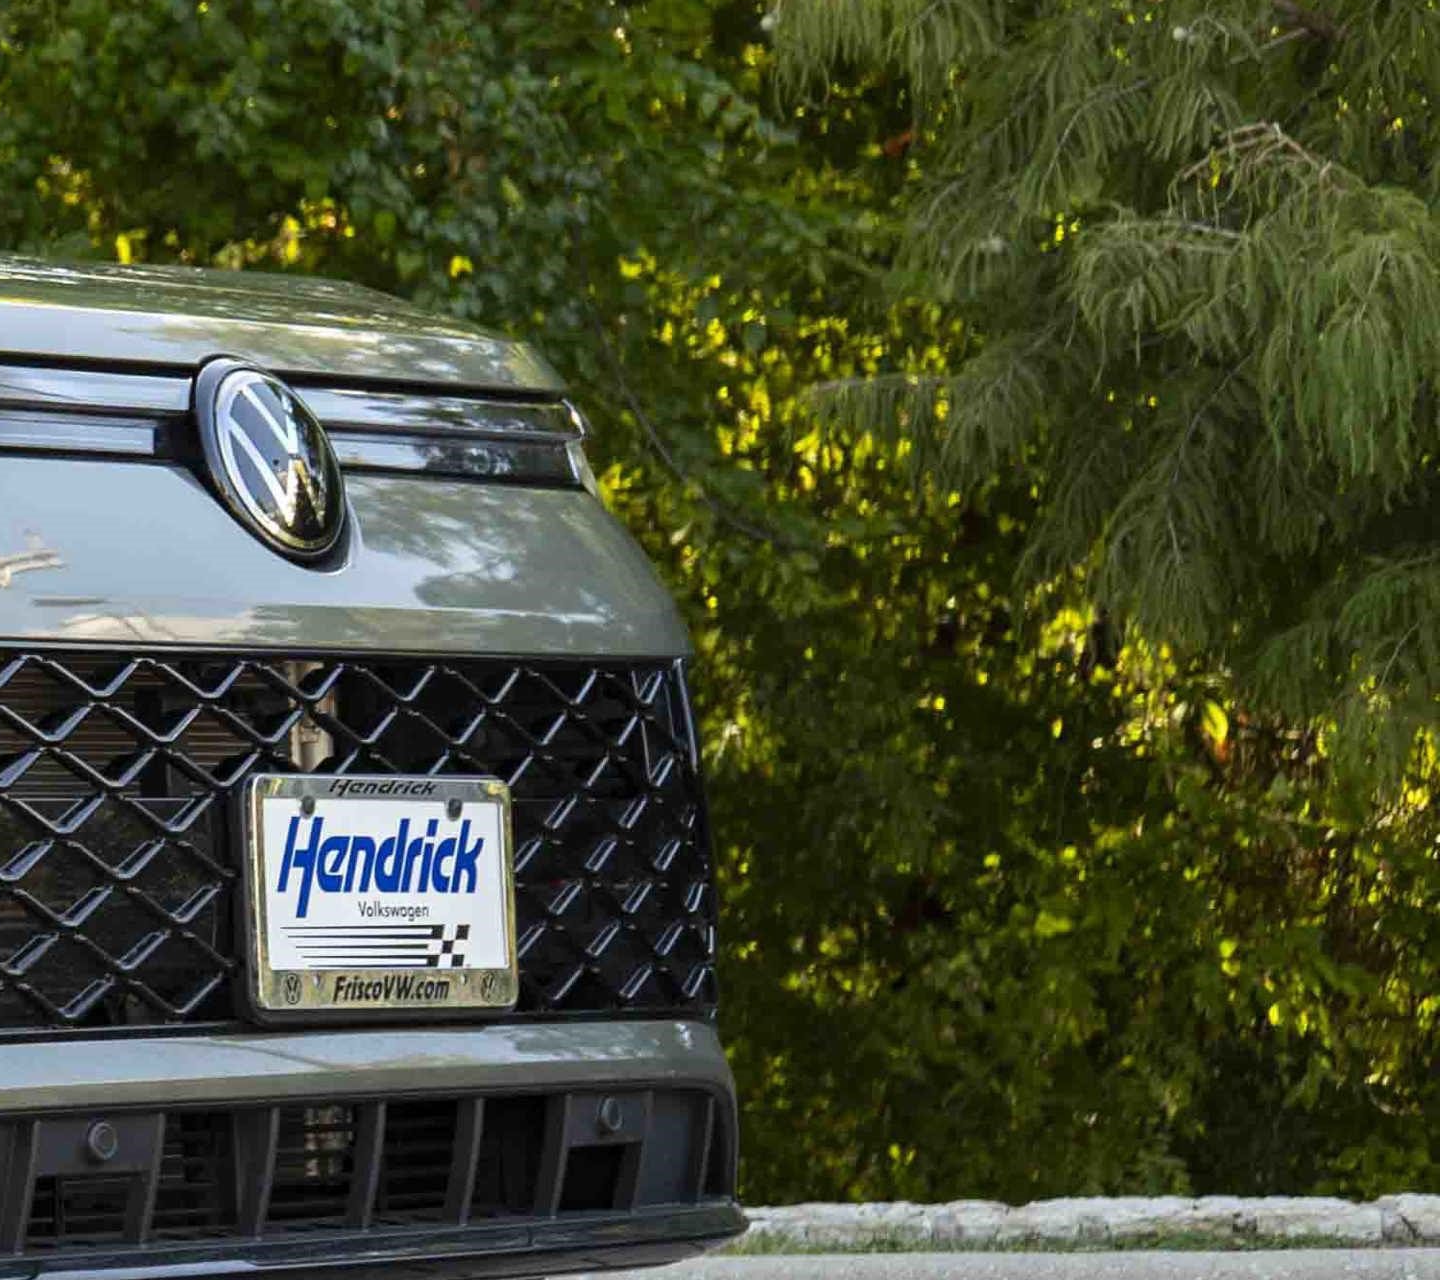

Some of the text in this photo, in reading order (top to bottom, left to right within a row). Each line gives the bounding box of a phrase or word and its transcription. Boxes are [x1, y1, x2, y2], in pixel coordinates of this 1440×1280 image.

[328, 779, 438, 798] Hendrick
[277, 816, 484, 918] Hendrick
[357, 901, 431, 922] Volkswagen
[332, 974, 451, 1003] FriscoVW.com
